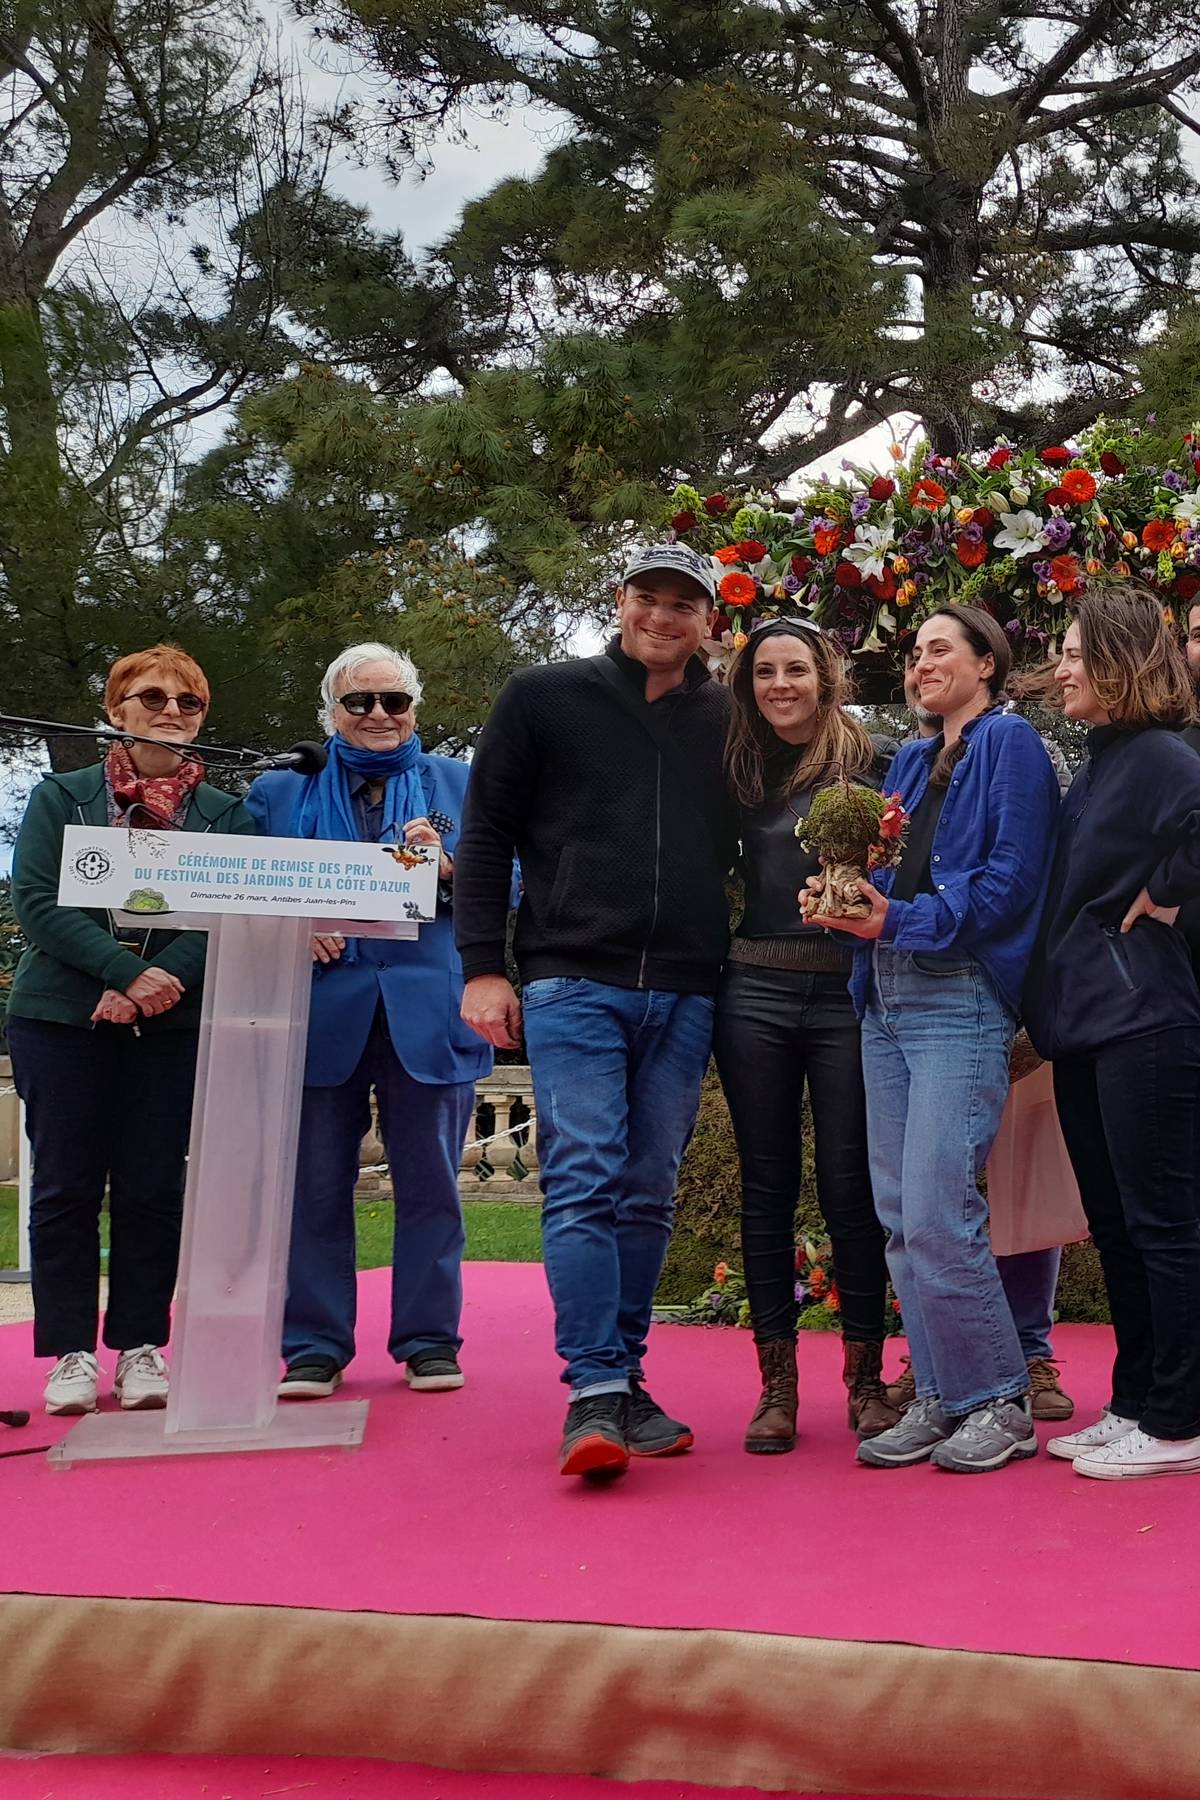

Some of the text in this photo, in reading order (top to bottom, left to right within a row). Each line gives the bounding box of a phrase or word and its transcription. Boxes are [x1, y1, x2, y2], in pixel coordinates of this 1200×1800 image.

[178, 851, 373, 876] CÉRÉMONIE DE REMISE DES PRIX
[134, 867, 152, 880] DU
[157, 868, 211, 883] FESTIVAL
[216, 872, 239, 885] DES
[243, 873, 294, 888] JARDINS
[298, 876, 313, 888] DE
[317, 877, 332, 890] LA
[370, 880, 411, 893] D'AZUR
[190, 891, 231, 900] Dimanche
[233, 893, 245, 901] 26
[271, 895, 302, 903] Antibes
[303, 897, 357, 906] Juan-les-Pins
